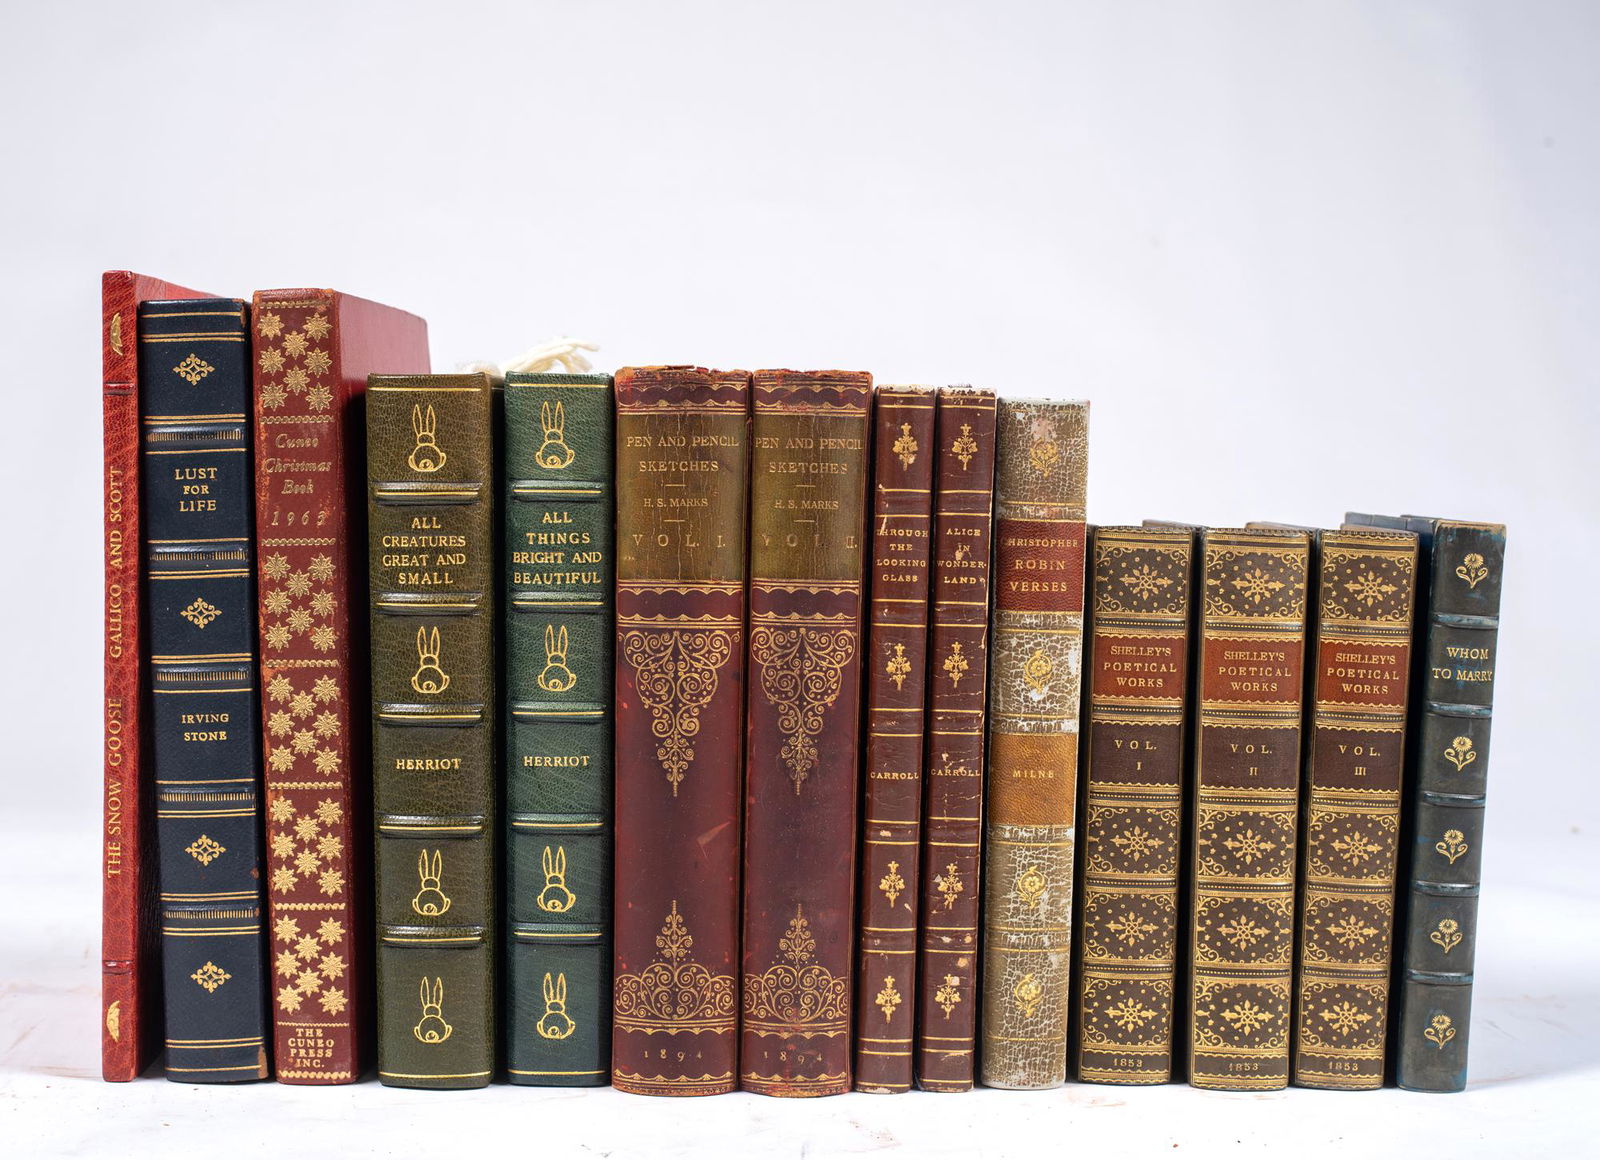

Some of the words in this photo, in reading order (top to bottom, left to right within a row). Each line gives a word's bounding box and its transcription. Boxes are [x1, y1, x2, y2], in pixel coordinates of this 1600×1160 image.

[275, 433, 319, 449] Cuneo
[626, 436, 652, 447] PEN
[658, 435, 686, 447] AND
[692, 435, 740, 447] PENCIL
[755, 437, 779, 449] PEN
[785, 438, 814, 449] AND
[820, 439, 863, 450] PENCIL
[264, 458, 332, 473] Christmas
[639, 461, 719, 472] SKETCHES
[769, 462, 849, 474] SKETCHES
[175, 467, 218, 480] LUST
[183, 485, 209, 495] FOR
[281, 479, 314, 495] Book
[110, 466, 123, 522] SCOTT
[179, 500, 217, 512] LIFE
[669, 498, 709, 508] MARKS
[801, 500, 839, 510] MARKS
[411, 517, 442, 529] ALL
[542, 511, 573, 524] ALL
[876, 529, 929, 538] THROUGH
[946, 528, 982, 537] ALICE
[382, 535, 466, 548] CREATURES
[526, 532, 591, 545] THINGS
[110, 529, 123, 570] AND
[889, 543, 913, 551] THE
[958, 544, 971, 552] IN
[382, 554, 429, 567] GREAT
[436, 553, 466, 566] AND
[512, 551, 565, 564] BRIGHT
[572, 551, 602, 564] AND
[877, 558, 926, 568] LOOKING
[1015, 559, 1066, 571] ROBIN
[398, 572, 454, 585] SMALL
[513, 572, 602, 585] BEAUTIFUL
[882, 574, 919, 583] GLASS
[944, 576, 977, 585] LAND
[1010, 581, 1068, 592] VERSES
[109, 584, 123, 659] GALLICO
[1110, 645, 1172, 656] SHELLEY'S
[1224, 650, 1286, 662] SHELLEY'S
[1446, 646, 1489, 660] WHOM
[1335, 652, 1396, 665] SHELLEY'S
[1103, 662, 1177, 673] POETICAL
[1218, 666, 1292, 677] POETICAL
[1327, 668, 1400, 680] POETICAL
[1432, 667, 1452, 679] TO
[1456, 669, 1493, 681] MARRY
[1116, 677, 1164, 688] WORKS
[1231, 681, 1278, 692] WORKS
[1341, 683, 1389, 695] WORKS
[181, 713, 229, 724] IRVING
[108, 698, 122, 767] GOOSE
[184, 731, 227, 741] STONE
[395, 758, 462, 770] HERRIOT
[523, 755, 590, 767] HERRIOT
[1136, 761, 1142, 771] I
[870, 771, 919, 780] CARROLL
[931, 768, 981, 777] CARROLL
[1012, 769, 1055, 778] MILNE
[1249, 767, 1258, 776] II
[1354, 766, 1366, 776] III
[108, 778, 122, 835] SNOW
[107, 841, 121, 879] THE
[295, 1028, 324, 1037] THE
[288, 1038, 335, 1048] CUNEO
[290, 1048, 333, 1058] PRESS
[294, 1058, 325, 1068] INC.
[1113, 1058, 1143, 1068] 1853
[1228, 1062, 1259, 1072] 1853
[1328, 1061, 1359, 1072] 1853
